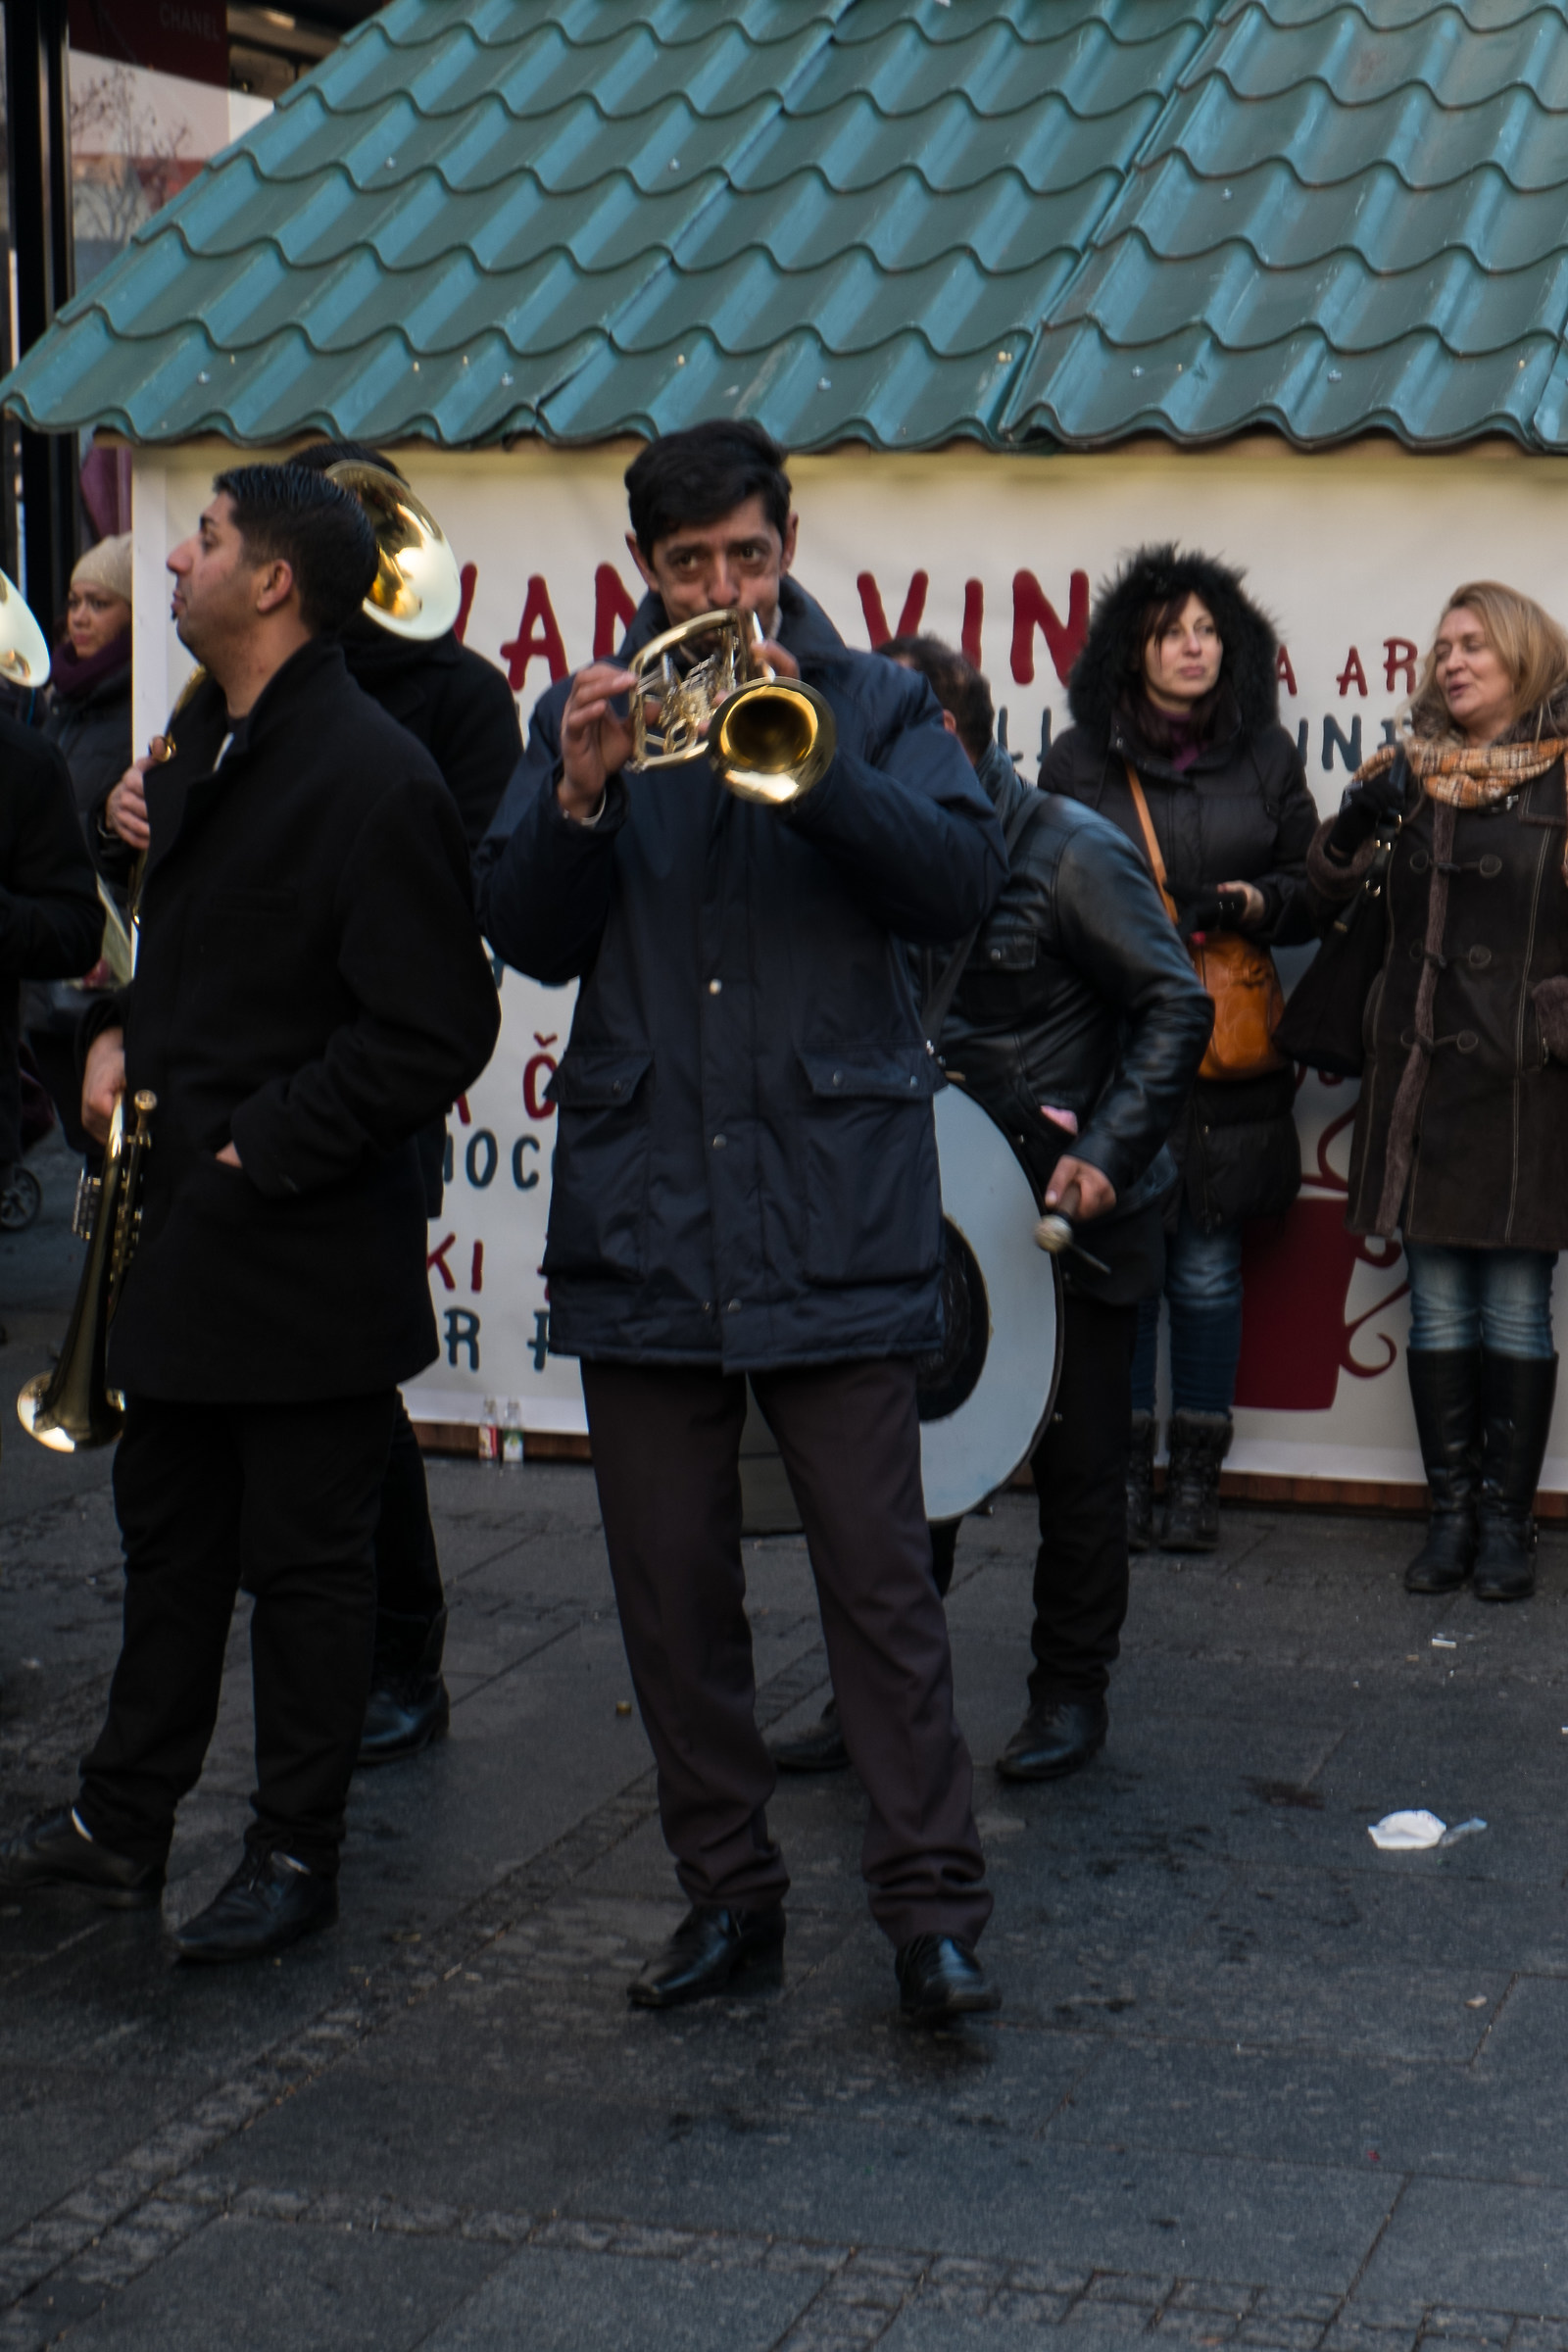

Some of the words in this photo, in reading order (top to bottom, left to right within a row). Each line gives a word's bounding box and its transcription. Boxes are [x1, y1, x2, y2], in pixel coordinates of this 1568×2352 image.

[159, 3, 220, 42] CHANEL
[856, 567, 1091, 690] VIN
[1335, 637, 1419, 697] AR
